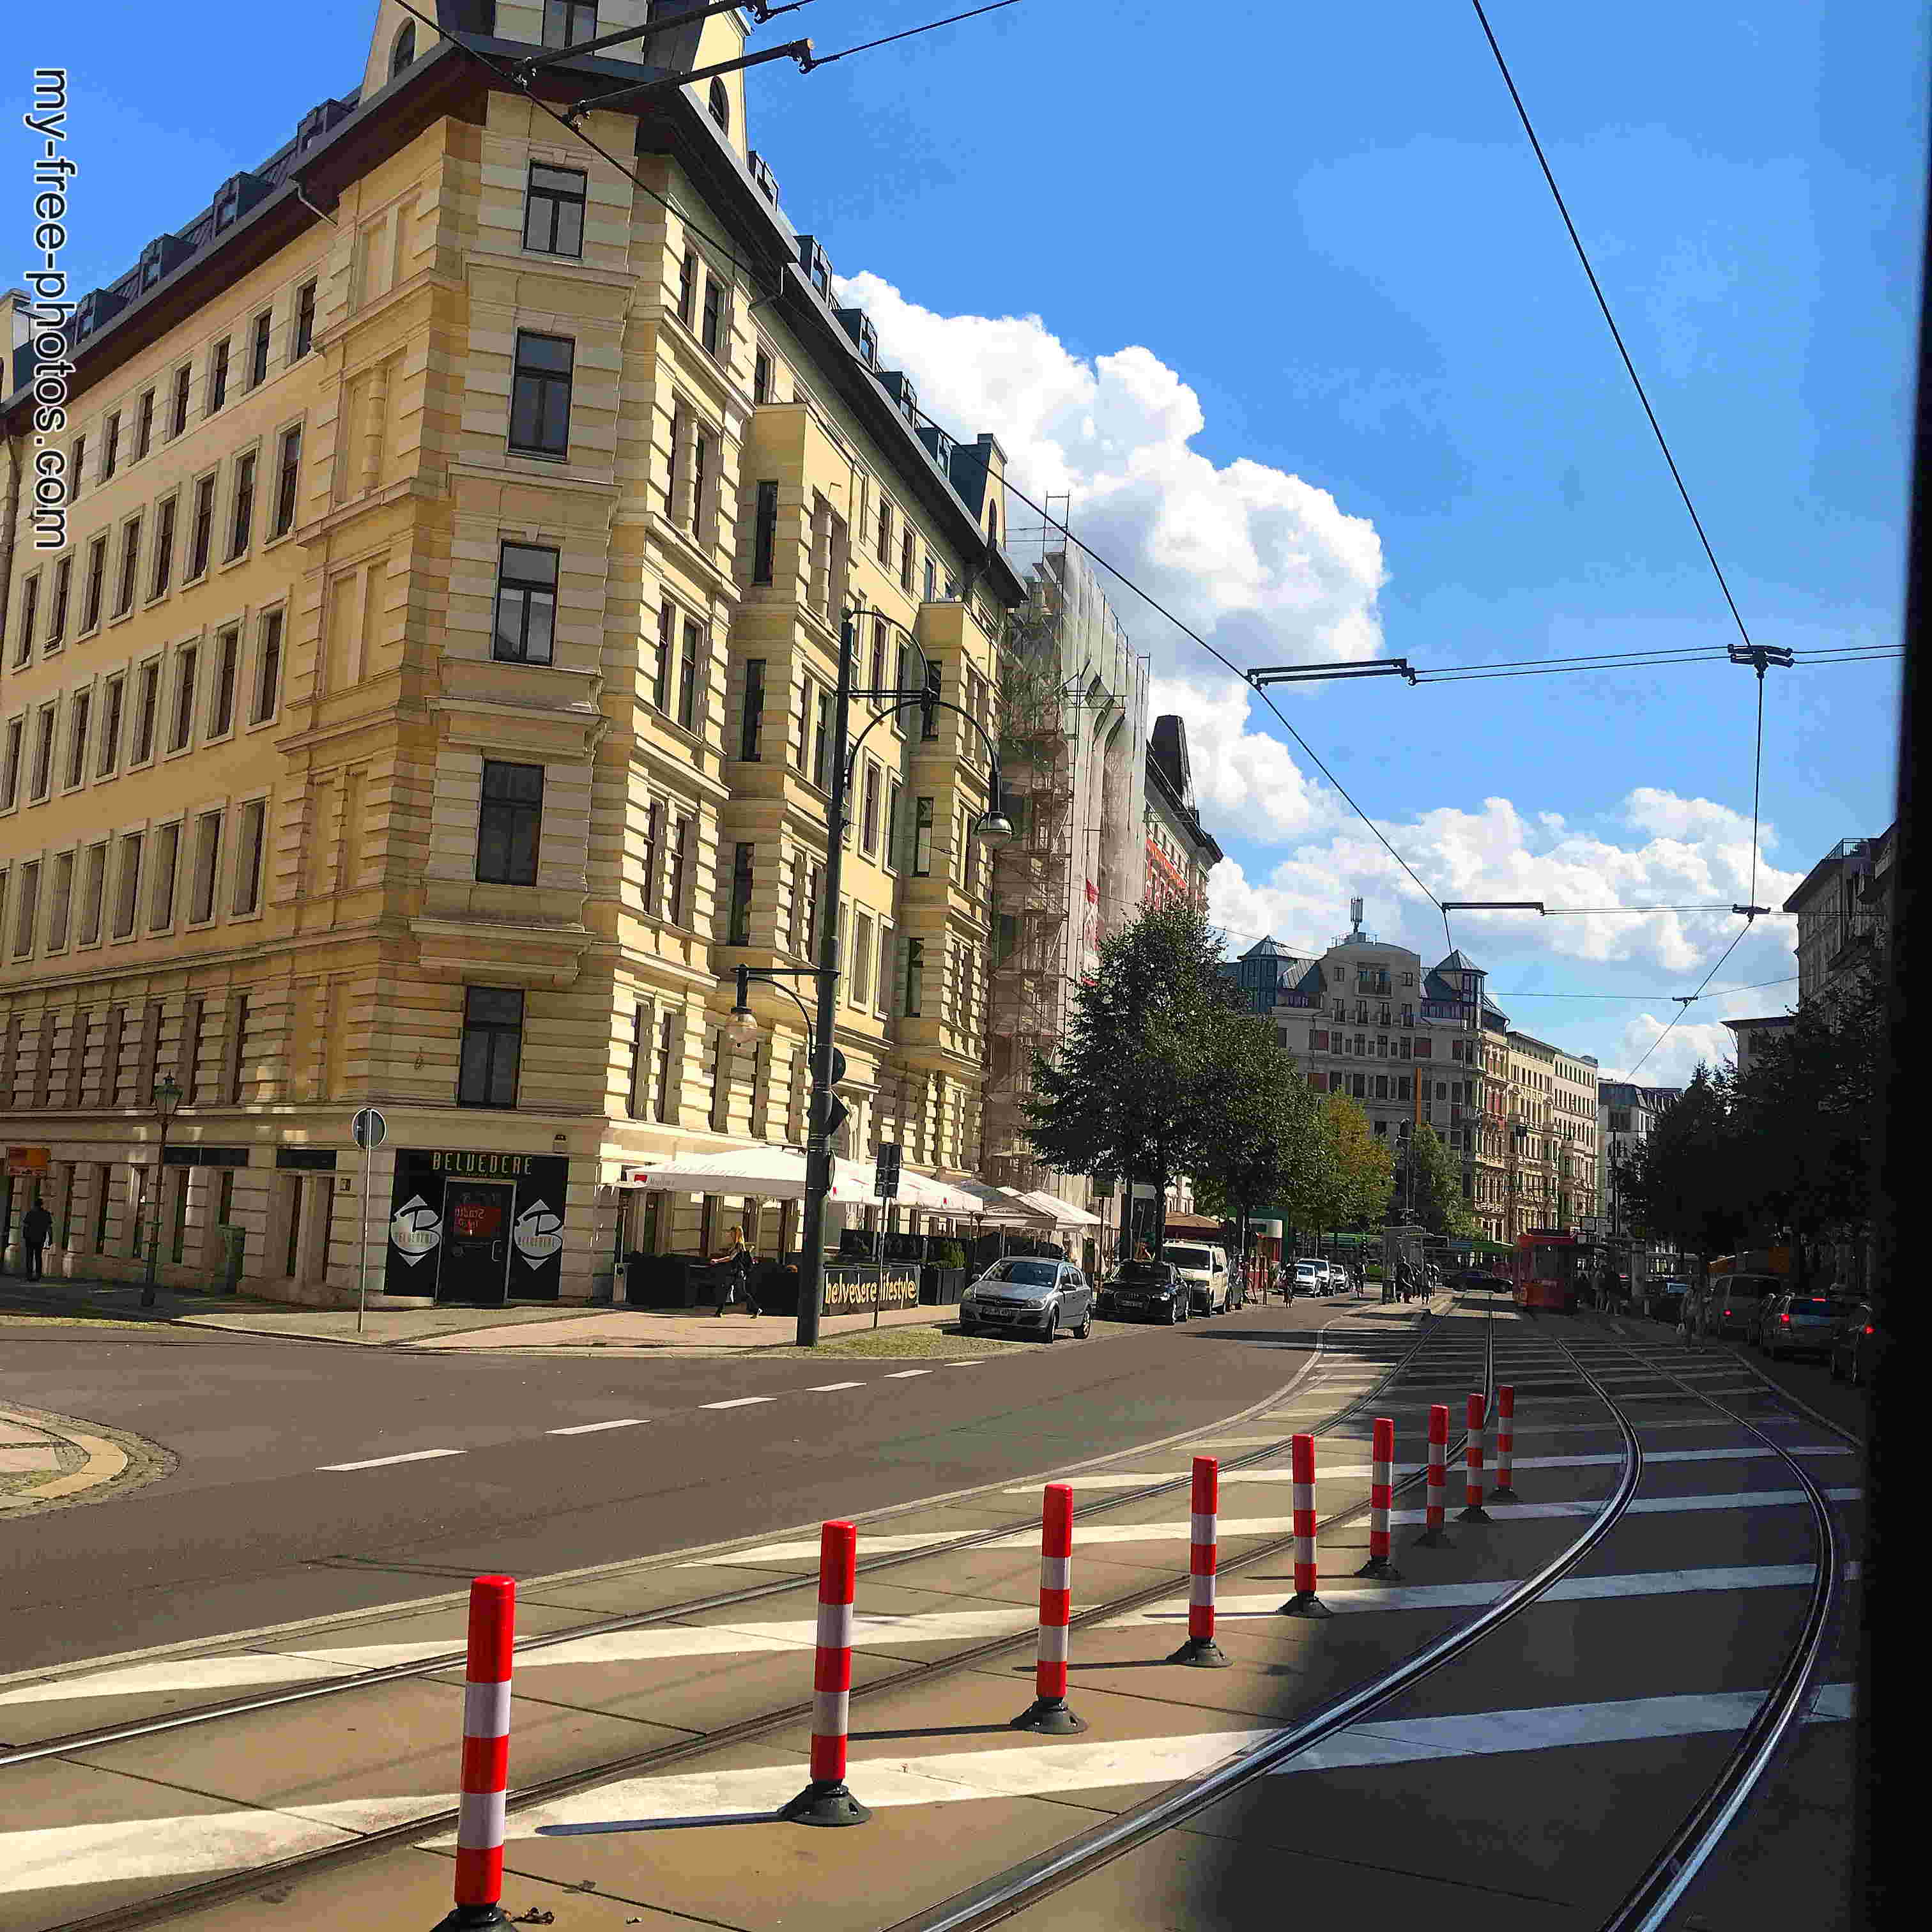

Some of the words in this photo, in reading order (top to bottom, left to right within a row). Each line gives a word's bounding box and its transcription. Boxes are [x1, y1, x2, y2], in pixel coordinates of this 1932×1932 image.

[433, 1152, 532, 1175] BELVEDERE
[825, 1272, 877, 1304] belvedere
[880, 1272, 916, 1308] lifestyle
